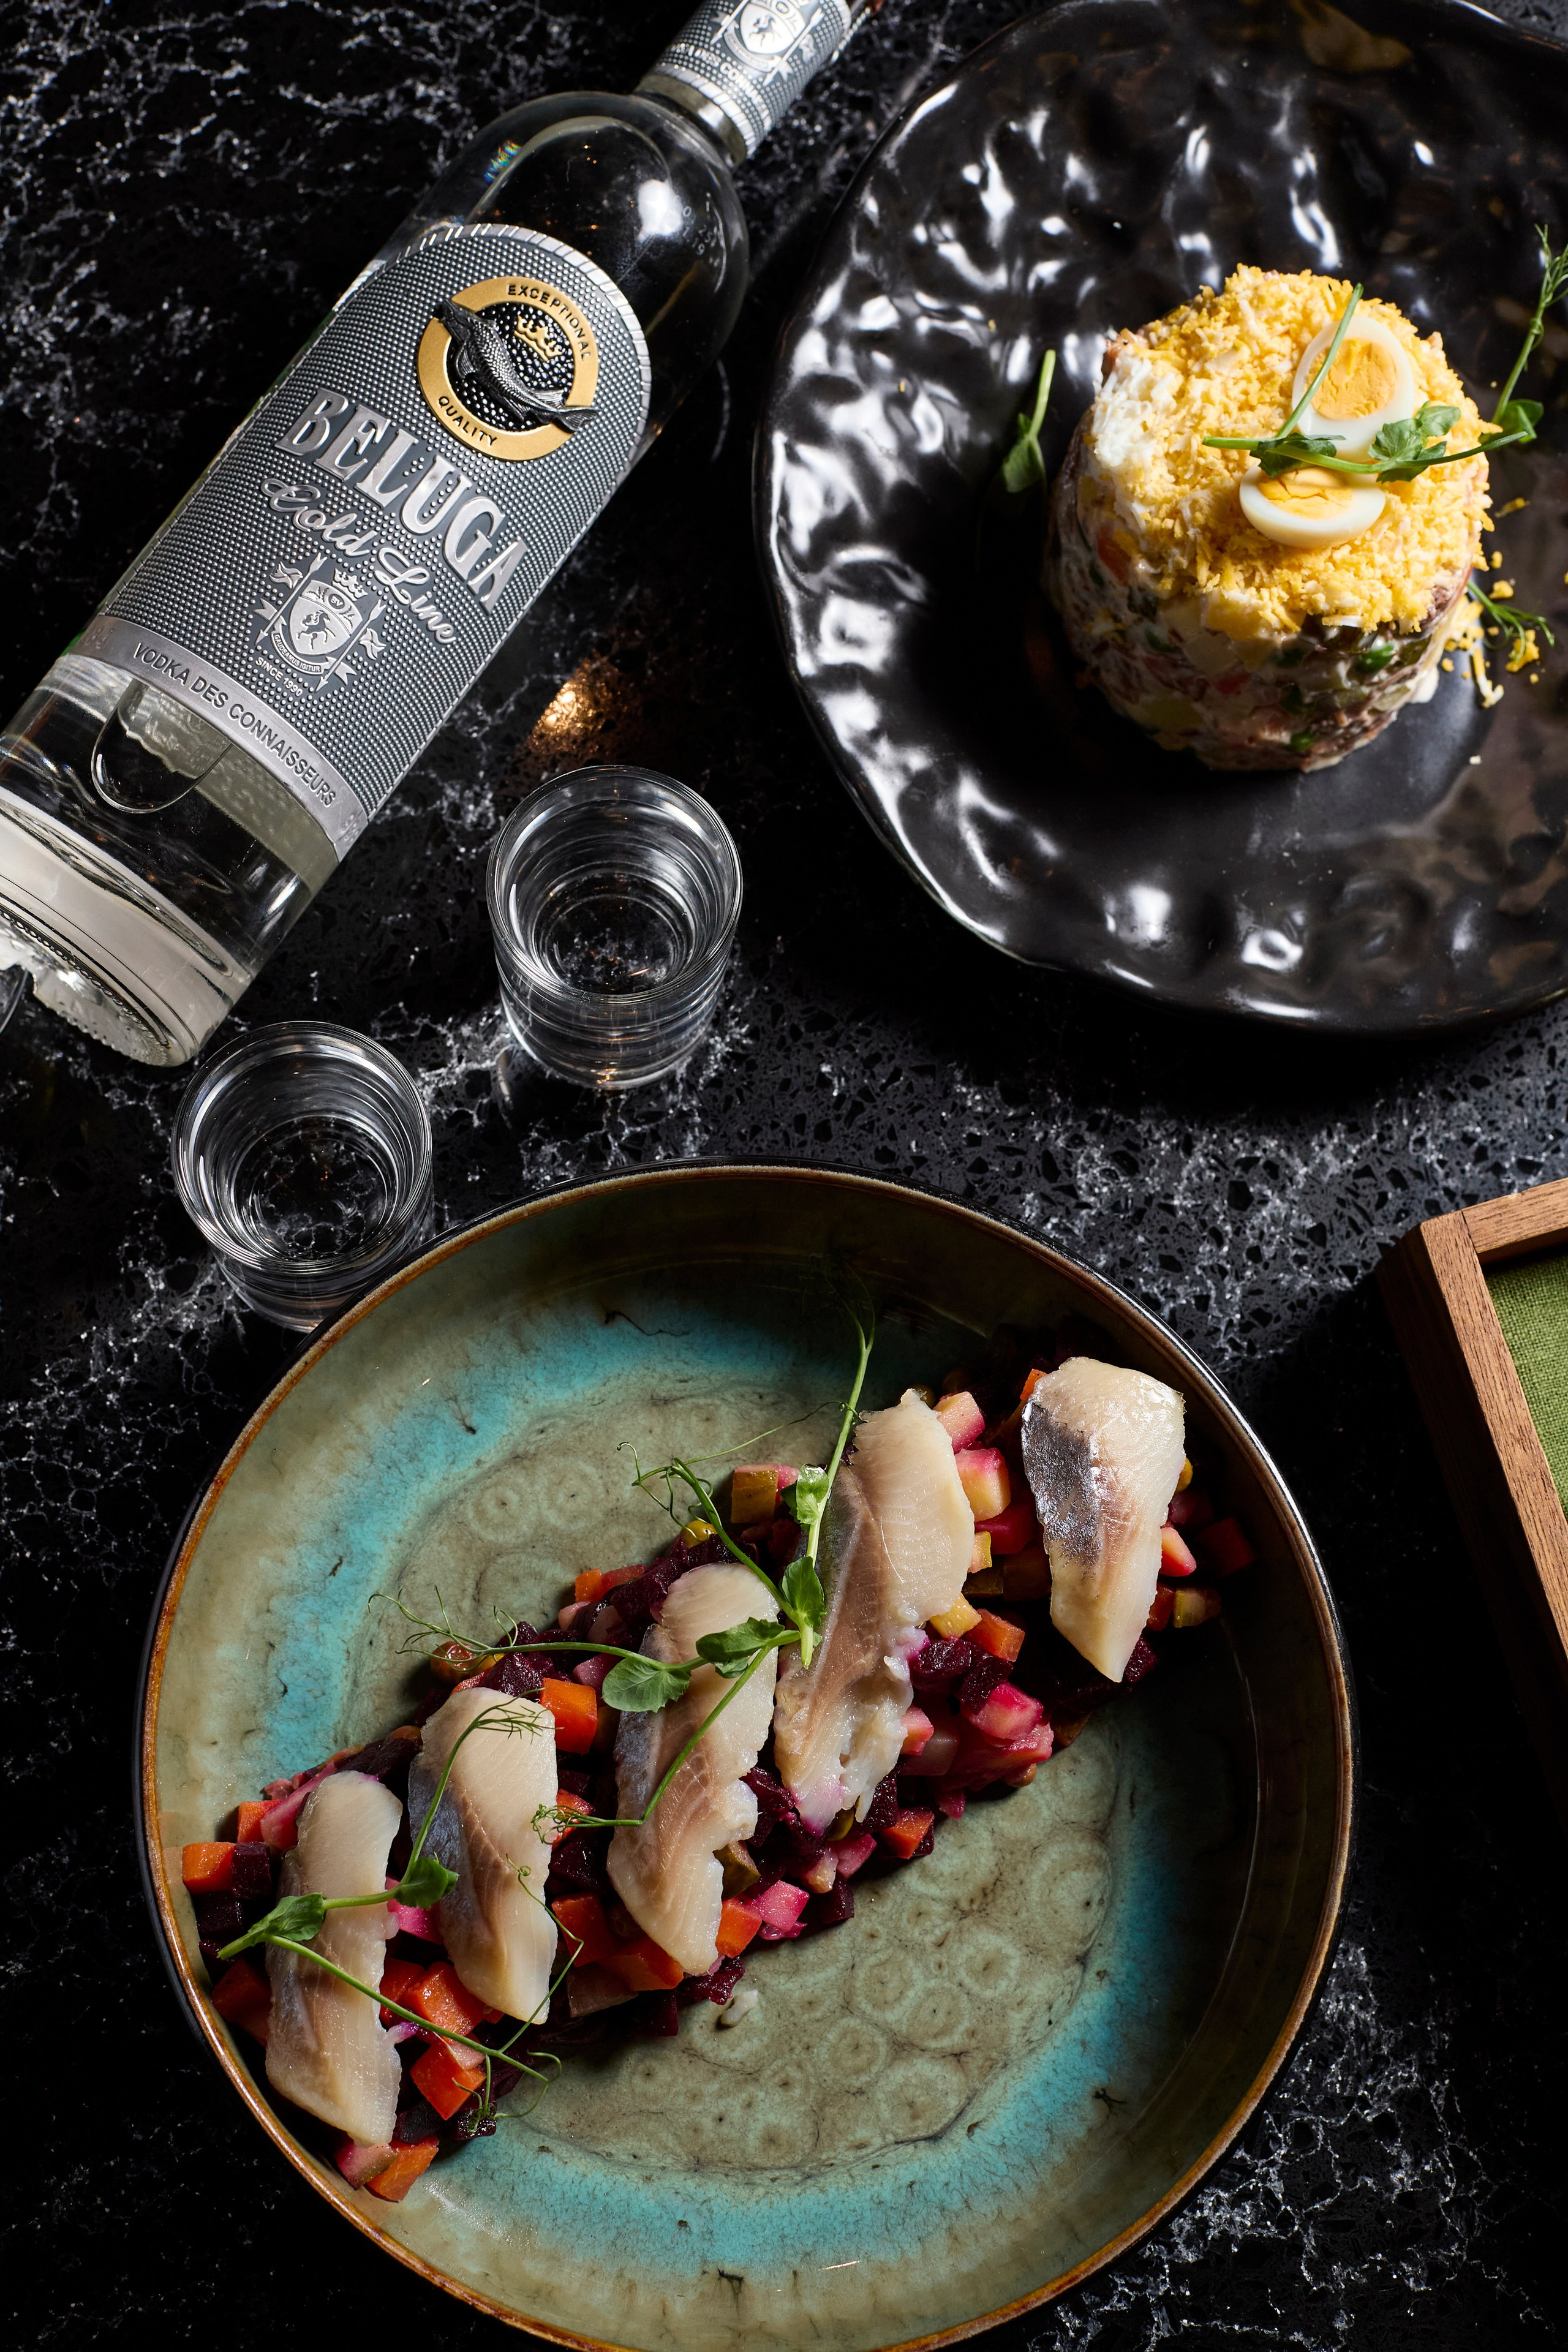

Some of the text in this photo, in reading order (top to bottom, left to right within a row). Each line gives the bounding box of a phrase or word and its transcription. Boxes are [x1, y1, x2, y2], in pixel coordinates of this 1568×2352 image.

[507, 284, 592, 361] EXCEPTIONAL
[438, 396, 497, 447] QUALITY
[274, 387, 530, 613] BELUGA
[373, 546, 457, 644] Line
[255, 657, 303, 696] SINCE 1990
[274, 633, 321, 673] GAUDEAMUS IGITUR
[132, 642, 337, 808] VODKA DES CONNAISSEURS
